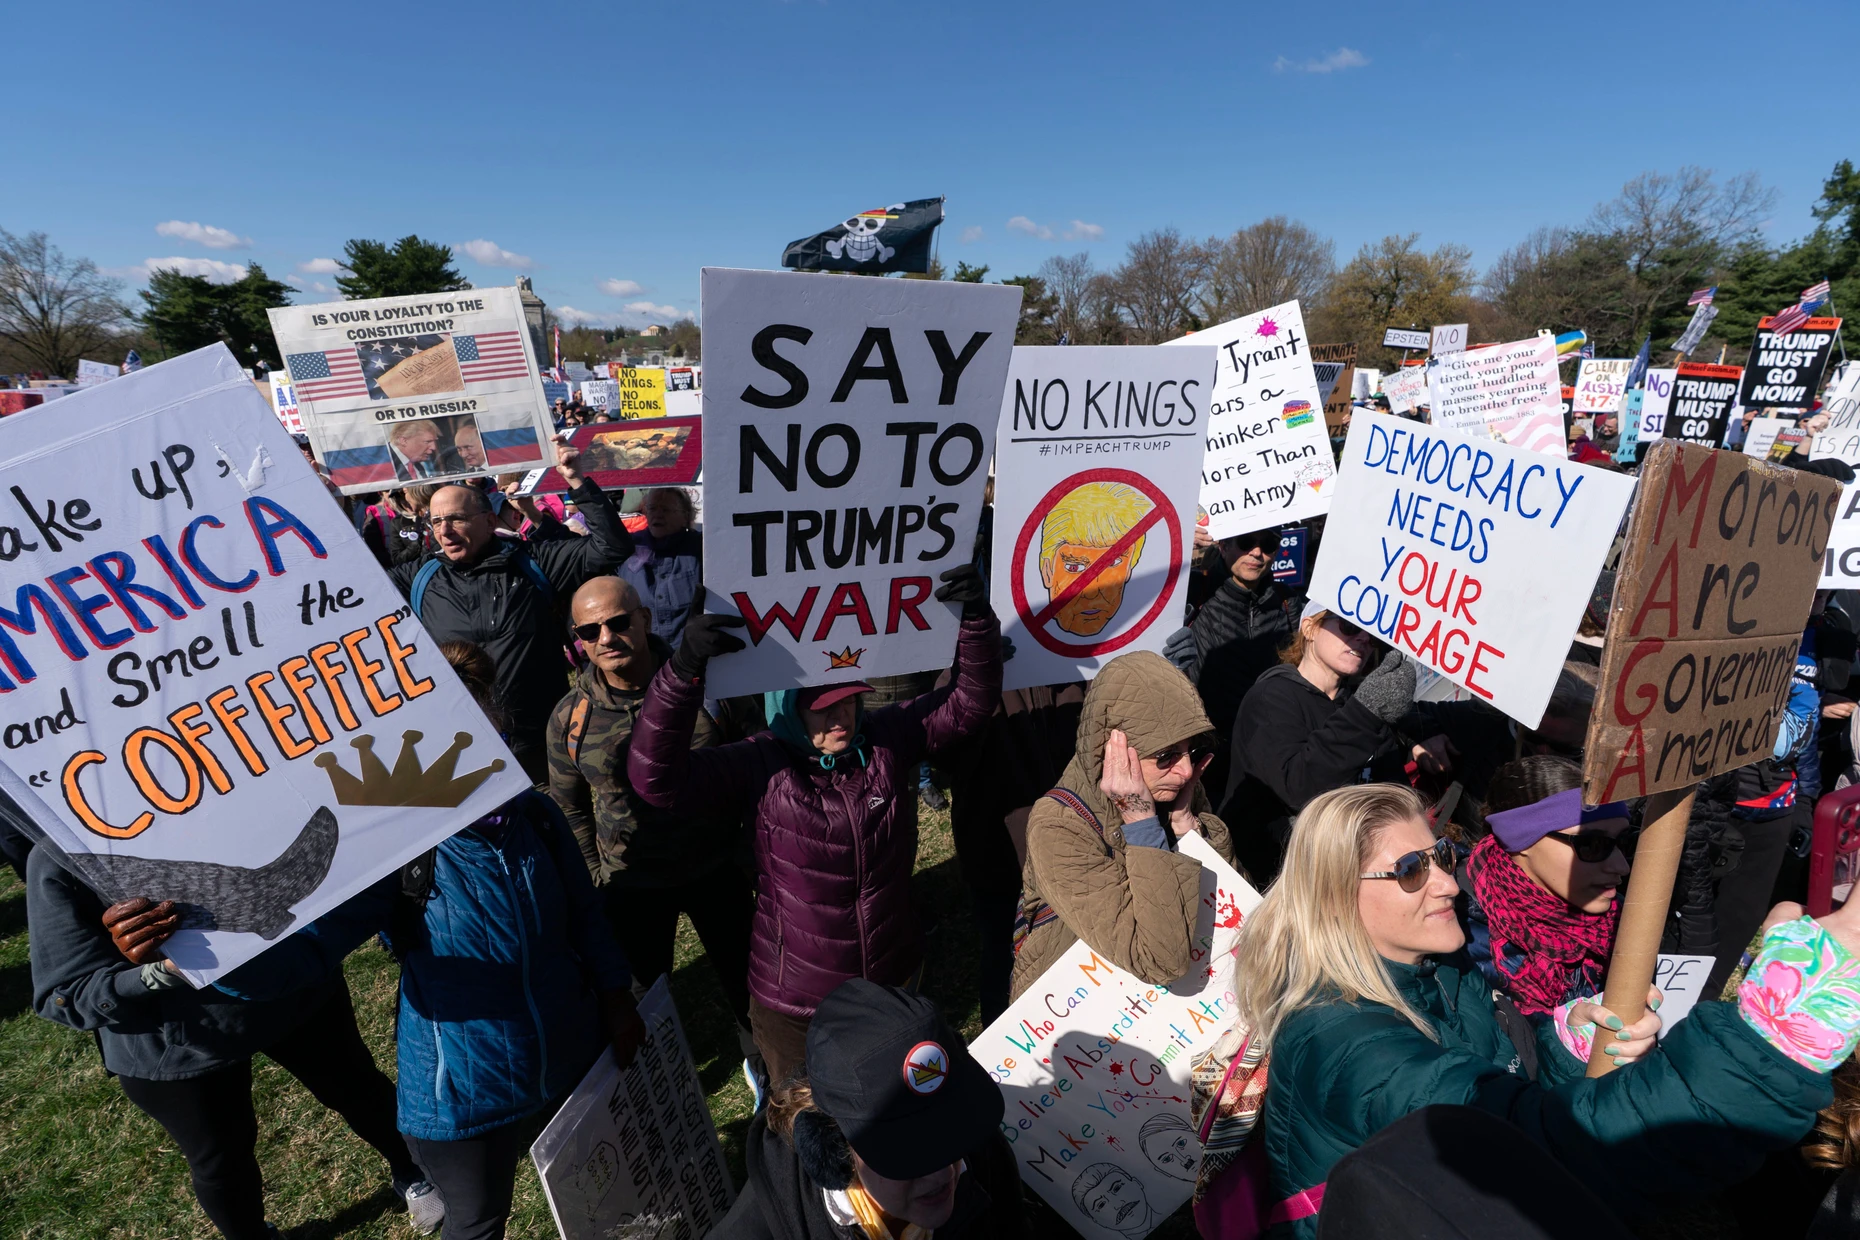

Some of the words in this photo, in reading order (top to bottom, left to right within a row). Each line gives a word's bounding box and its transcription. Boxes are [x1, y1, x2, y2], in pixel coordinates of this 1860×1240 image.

[312, 314, 328, 326] IS
[330, 310, 371, 324] YOUR
[374, 304, 433, 321] LOYALTY
[436, 302, 454, 314] TO
[457, 299, 484, 312] THE
[346, 319, 454, 341] CONSTITUTION?
[1385, 332, 1430, 345] EPSTEIN
[1435, 328, 1459, 347] NO
[1759, 333, 1831, 350] TRUMP
[740, 323, 993, 410] SAY
[1223, 329, 1301, 384] Tyrant
[1440, 371, 1474, 384] tired,
[1477, 366, 1506, 379] your
[1510, 360, 1544, 373] poor,
[1483, 355, 1502, 364] me
[1506, 349, 1536, 362] your
[1683, 364, 1738, 375] RefuseFascism.org
[1758, 351, 1817, 368] MUST
[620, 378, 656, 388] KINGS.
[621, 369, 636, 378] NO
[1402, 369, 1418, 379] KING
[1450, 382, 1479, 396] your
[1482, 370, 1535, 388] huddled
[1647, 373, 1670, 398] NO
[1767, 368, 1797, 385] GO
[621, 400, 661, 410] FELONS.
[623, 391, 638, 399] NO
[1012, 378, 1070, 431] NO
[1083, 378, 1200, 430] KINGS
[1210, 396, 1245, 416] ars
[1260, 388, 1285, 401] a
[1442, 393, 1485, 406] masses
[1489, 381, 1547, 400] yearning
[1586, 394, 1610, 408] 47
[1677, 380, 1736, 400] TRUMP
[1751, 386, 1807, 402] NOW!
[375, 408, 395, 421] OR
[398, 405, 416, 418] TO
[419, 400, 477, 416] RUSSIA?
[1442, 409, 1455, 418] to
[1459, 400, 1507, 414] breathe
[1456, 420, 1480, 429] Emma
[1482, 414, 1515, 425] Lazarus,
[1516, 410, 1536, 418] 1883
[1675, 400, 1726, 419] MUST
[1206, 417, 1280, 452] hinker
[1682, 419, 1709, 437] GO
[1784, 427, 1806, 436] HISTO
[739, 422, 860, 494] NO
[886, 422, 983, 489] TO
[1038, 439, 1171, 456] #IMPEACHTRUMP
[1257, 444, 1316, 467] Than
[1814, 436, 1836, 454] IS
[1364, 424, 1584, 528] DEMOCRACY
[1209, 498, 1235, 516] an
[1244, 481, 1296, 509] Army
[1654, 446, 1839, 562] Morons
[0, 485, 102, 561] ake
[732, 495, 959, 577] TRUMP'S
[1387, 488, 1494, 564] NEEDS
[0, 495, 328, 693] MERICA
[1380, 537, 1482, 626] YOUR
[1630, 536, 1760, 638] Are
[731, 576, 933, 648] WAR
[1338, 575, 1506, 700] COURAGE
[3, 688, 87, 749] and
[107, 601, 264, 707] Smell
[297, 580, 364, 625] the
[1614, 637, 1799, 726] Governing
[1600, 708, 1772, 804] America
[1657, 958, 1701, 991] PE
[657, 1016, 681, 1063] FIND
[989, 1056, 1017, 1085] ose
[1006, 1018, 1055, 1054] Who
[1045, 984, 1089, 1019] Can
[1001, 1075, 1073, 1145] Believe
[1063, 982, 1171, 1081] Absurdities
[1190, 935, 1216, 962] an
[672, 1056, 691, 1095] THE
[608, 1081, 628, 1125] WE
[640, 1033, 670, 1106] BURIED
[661, 1100, 679, 1131] IN
[670, 1121, 689, 1164] THE
[682, 1091, 704, 1134] COST
[1027, 1123, 1096, 1183] Make
[1087, 1091, 1139, 1122] You
[1130, 1023, 1194, 1087] Commit
[619, 1115, 640, 1162] WILL
[694, 1130, 710, 1152] OF
[587, 1159, 604, 1191] Good
[628, 1151, 653, 1199] NOT
[643, 1118, 666, 1167] MORE
[655, 1155, 676, 1203] WILL
[699, 1146, 732, 1213] FREEDOM
